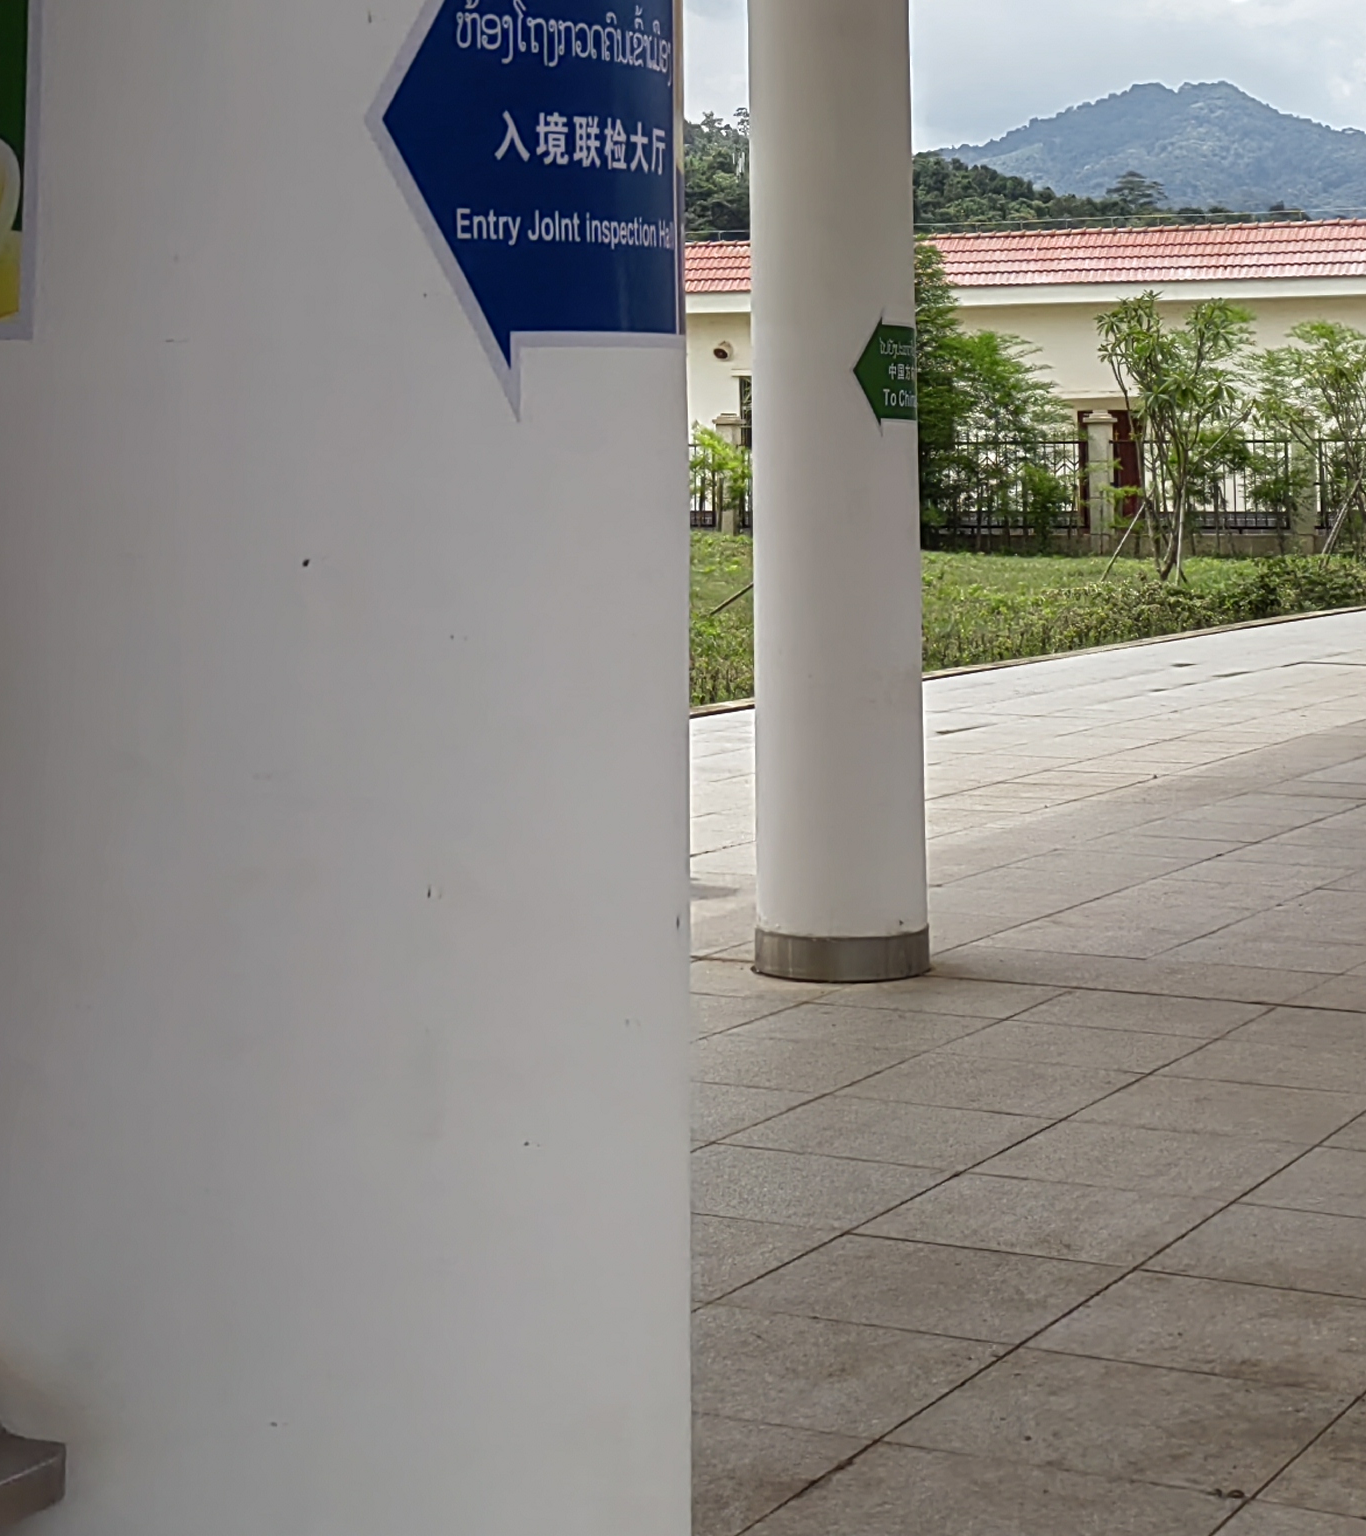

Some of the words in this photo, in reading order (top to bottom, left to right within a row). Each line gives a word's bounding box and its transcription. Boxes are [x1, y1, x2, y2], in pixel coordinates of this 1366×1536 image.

[494, 110, 666, 175] 入境联检大厅
[456, 208, 521, 245] Entry
[883, 389, 897, 406] To
